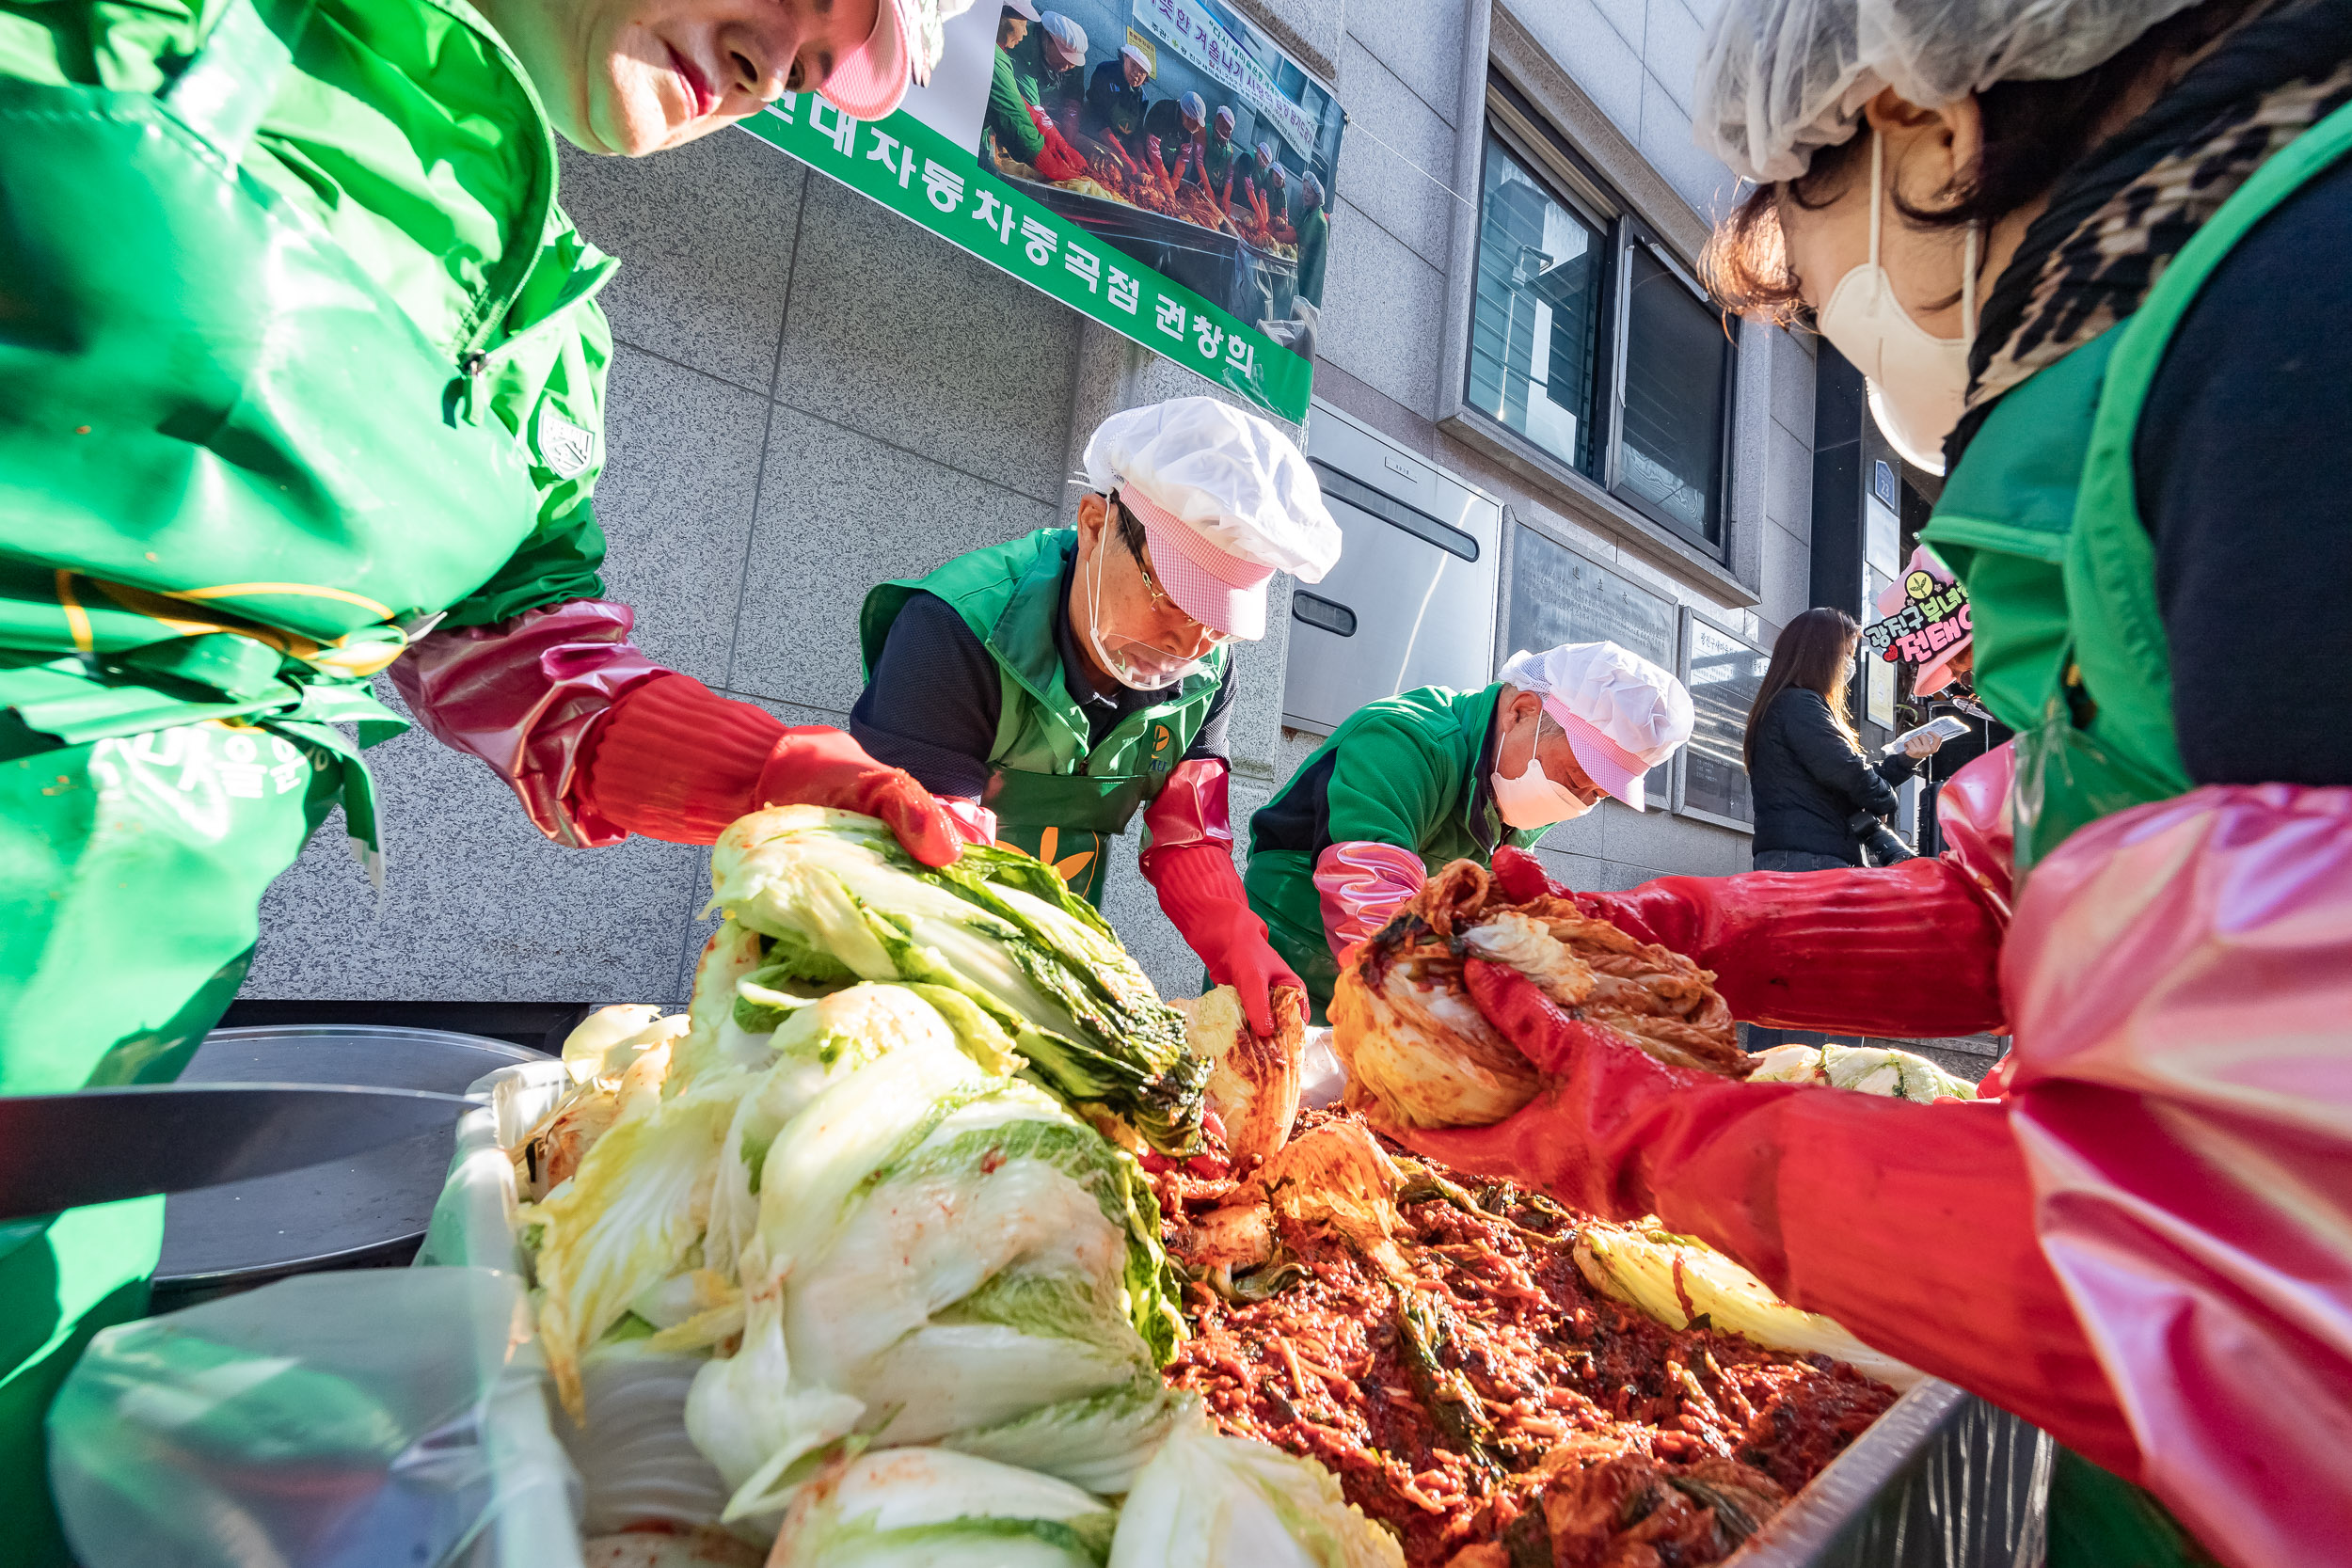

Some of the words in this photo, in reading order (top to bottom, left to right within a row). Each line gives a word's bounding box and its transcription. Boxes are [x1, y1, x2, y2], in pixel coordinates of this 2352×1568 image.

[1196, 24, 1244, 83] 겨울나기
[1155, 293, 1254, 379] 권창희
[1881, 480, 1889, 499] 23
[1865, 605, 1924, 648] 광진구
